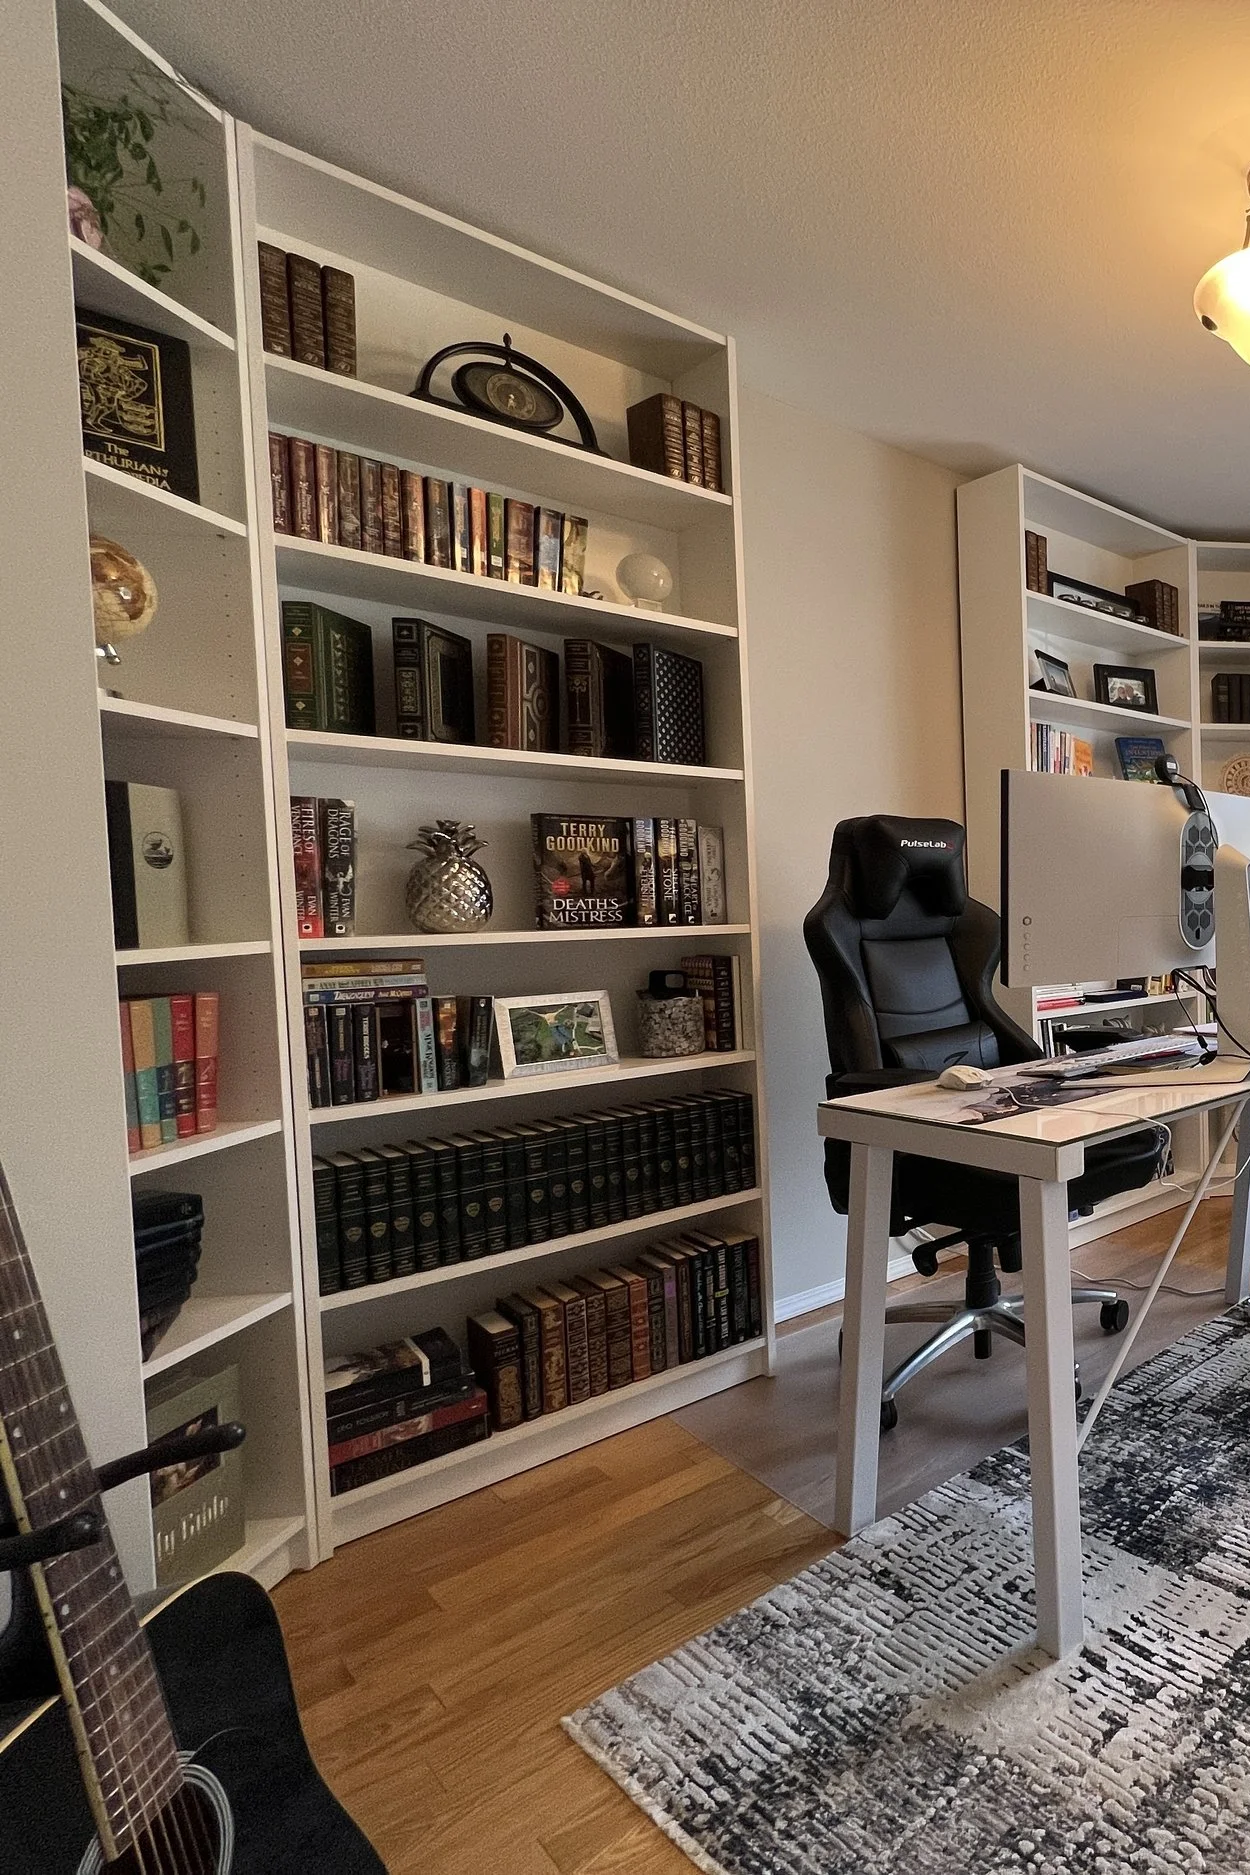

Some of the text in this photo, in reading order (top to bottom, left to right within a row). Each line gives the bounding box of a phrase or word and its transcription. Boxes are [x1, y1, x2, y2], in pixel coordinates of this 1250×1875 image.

[84, 449, 160, 476] RTHURIAN
[103, 441, 129, 457] The
[302, 808, 315, 842] FIRES
[327, 808, 339, 859] DRAGONS
[339, 811, 351, 843] RAGE
[560, 822, 606, 837] TERRY
[636, 820, 646, 853] GOODKIND
[546, 836, 620, 853] GOODKIND
[662, 868, 673, 902] STONE
[682, 872, 692, 915] BLACK ICE
[307, 895, 317, 916] EVAN
[330, 892, 340, 923] WINTER
[341, 898, 351, 918] EVAN
[549, 909, 623, 923] MISTRESS
[553, 898, 619, 911] DEATH'S
